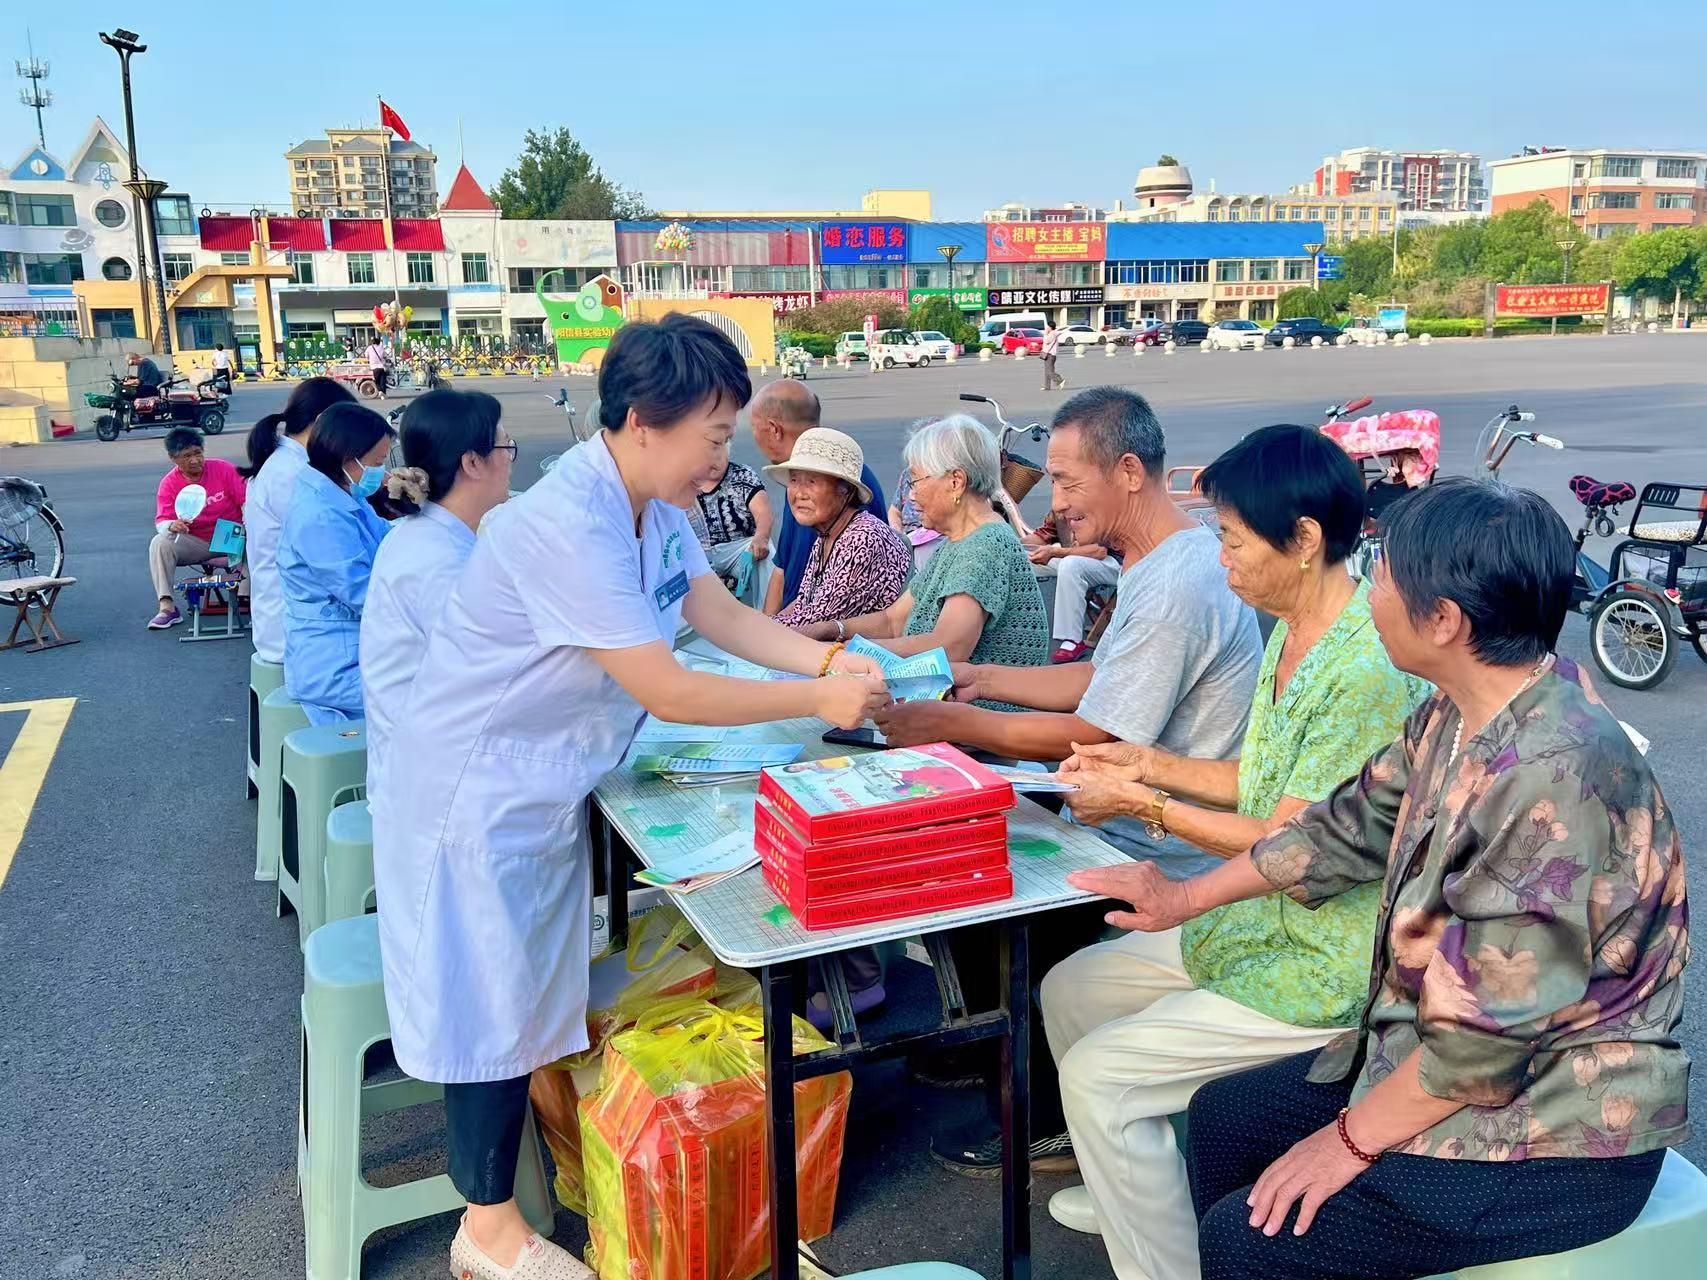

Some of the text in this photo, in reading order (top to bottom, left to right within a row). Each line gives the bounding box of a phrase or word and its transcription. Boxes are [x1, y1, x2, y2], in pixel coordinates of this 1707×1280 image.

[823, 226, 905, 248] 婚恋服务
[1012, 226, 1102, 243] 招聘女主播 宝妈
